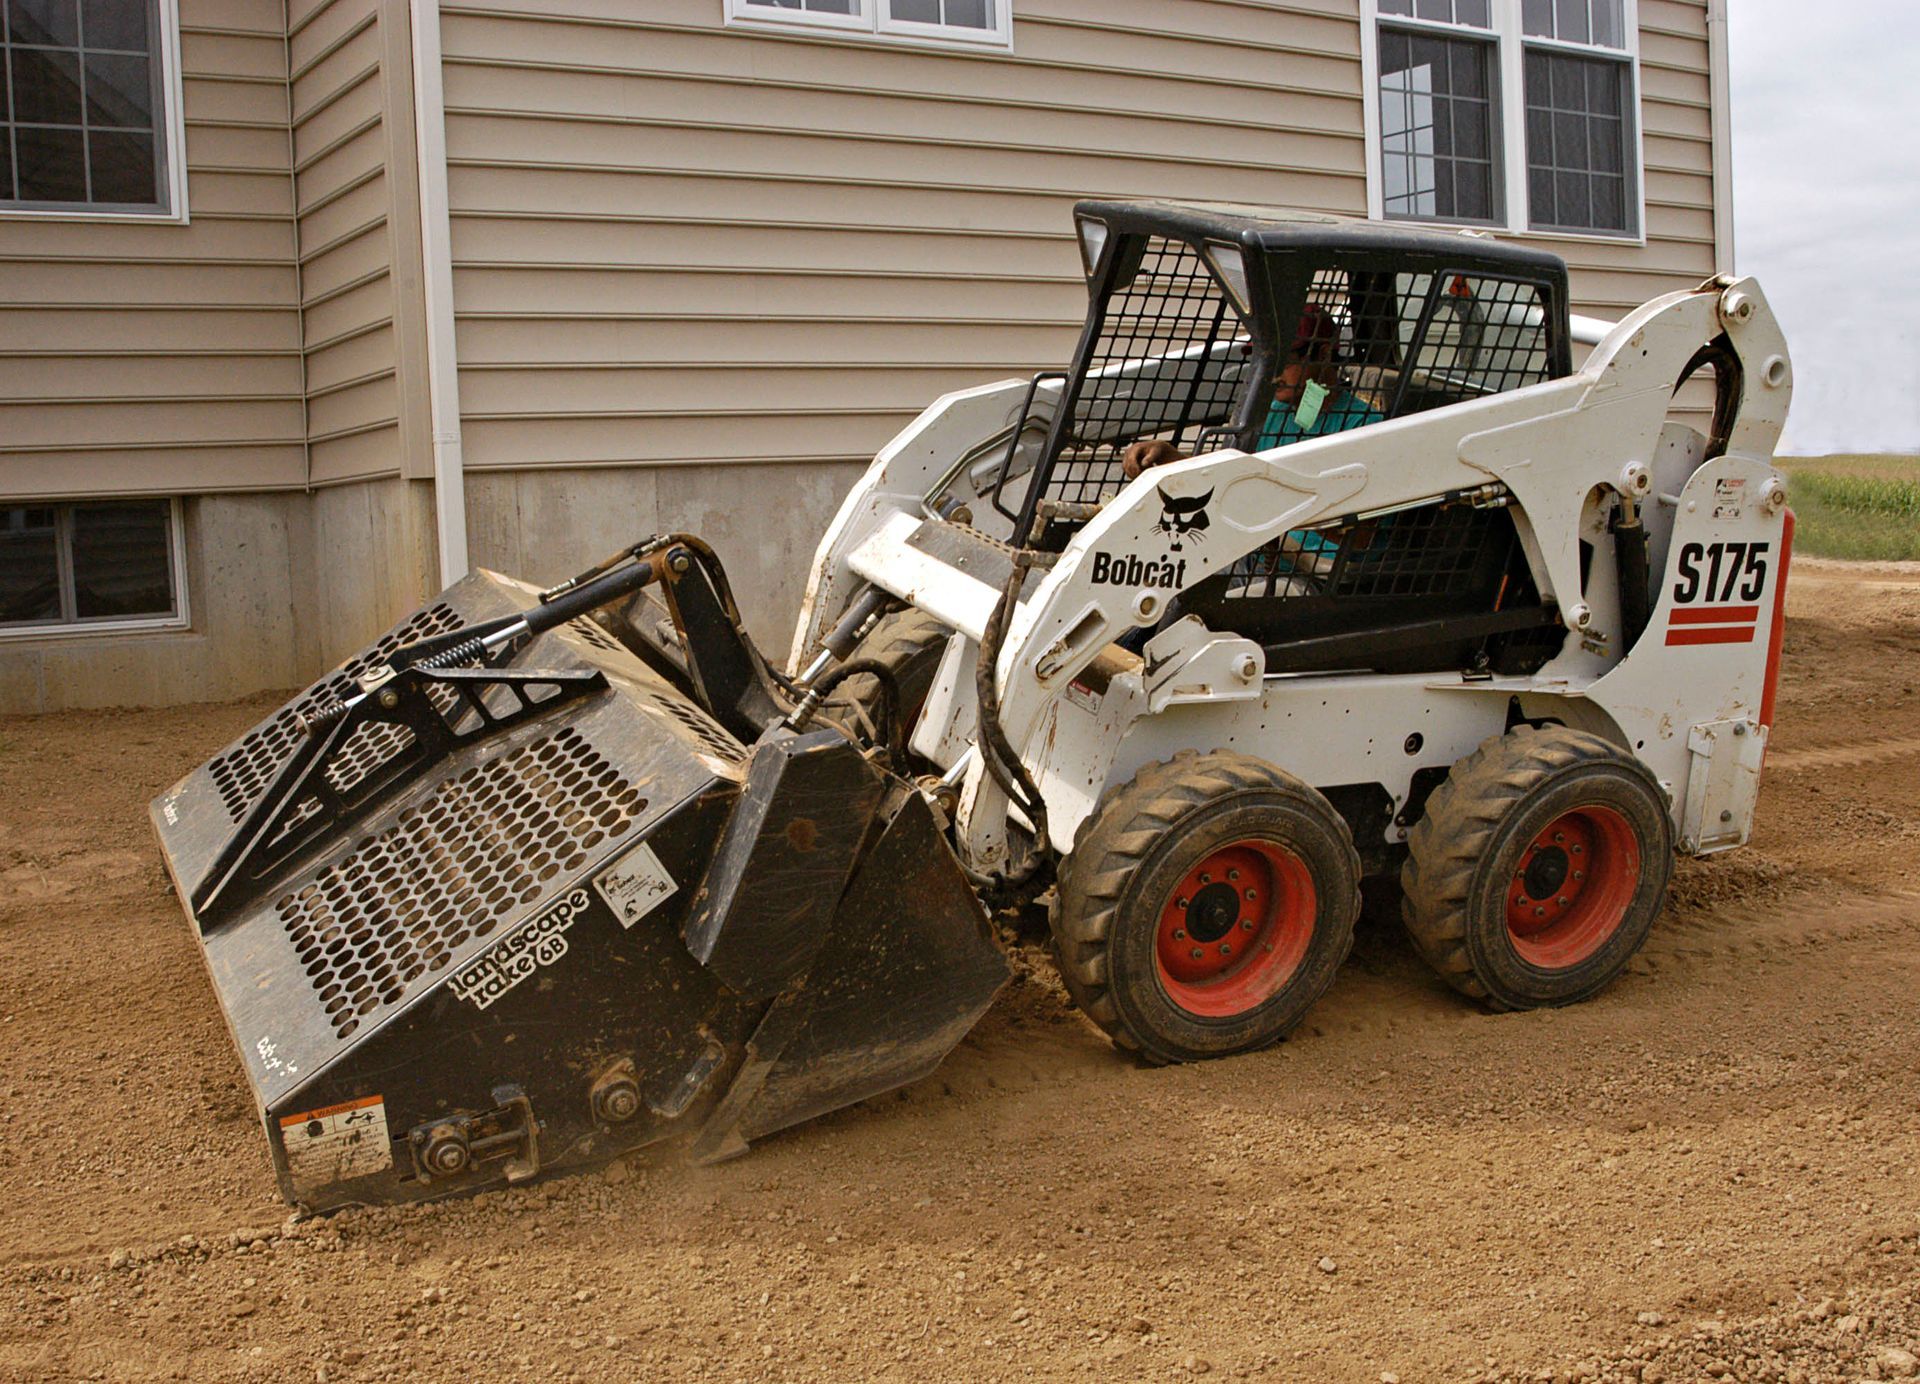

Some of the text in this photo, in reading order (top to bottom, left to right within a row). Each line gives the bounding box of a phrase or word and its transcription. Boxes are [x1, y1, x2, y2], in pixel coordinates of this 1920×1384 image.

[1091, 552, 1185, 589] Bobcat
[1674, 542, 1770, 604] S175
[448, 889, 588, 996] landscape
[473, 937, 565, 1005] rake 6B
